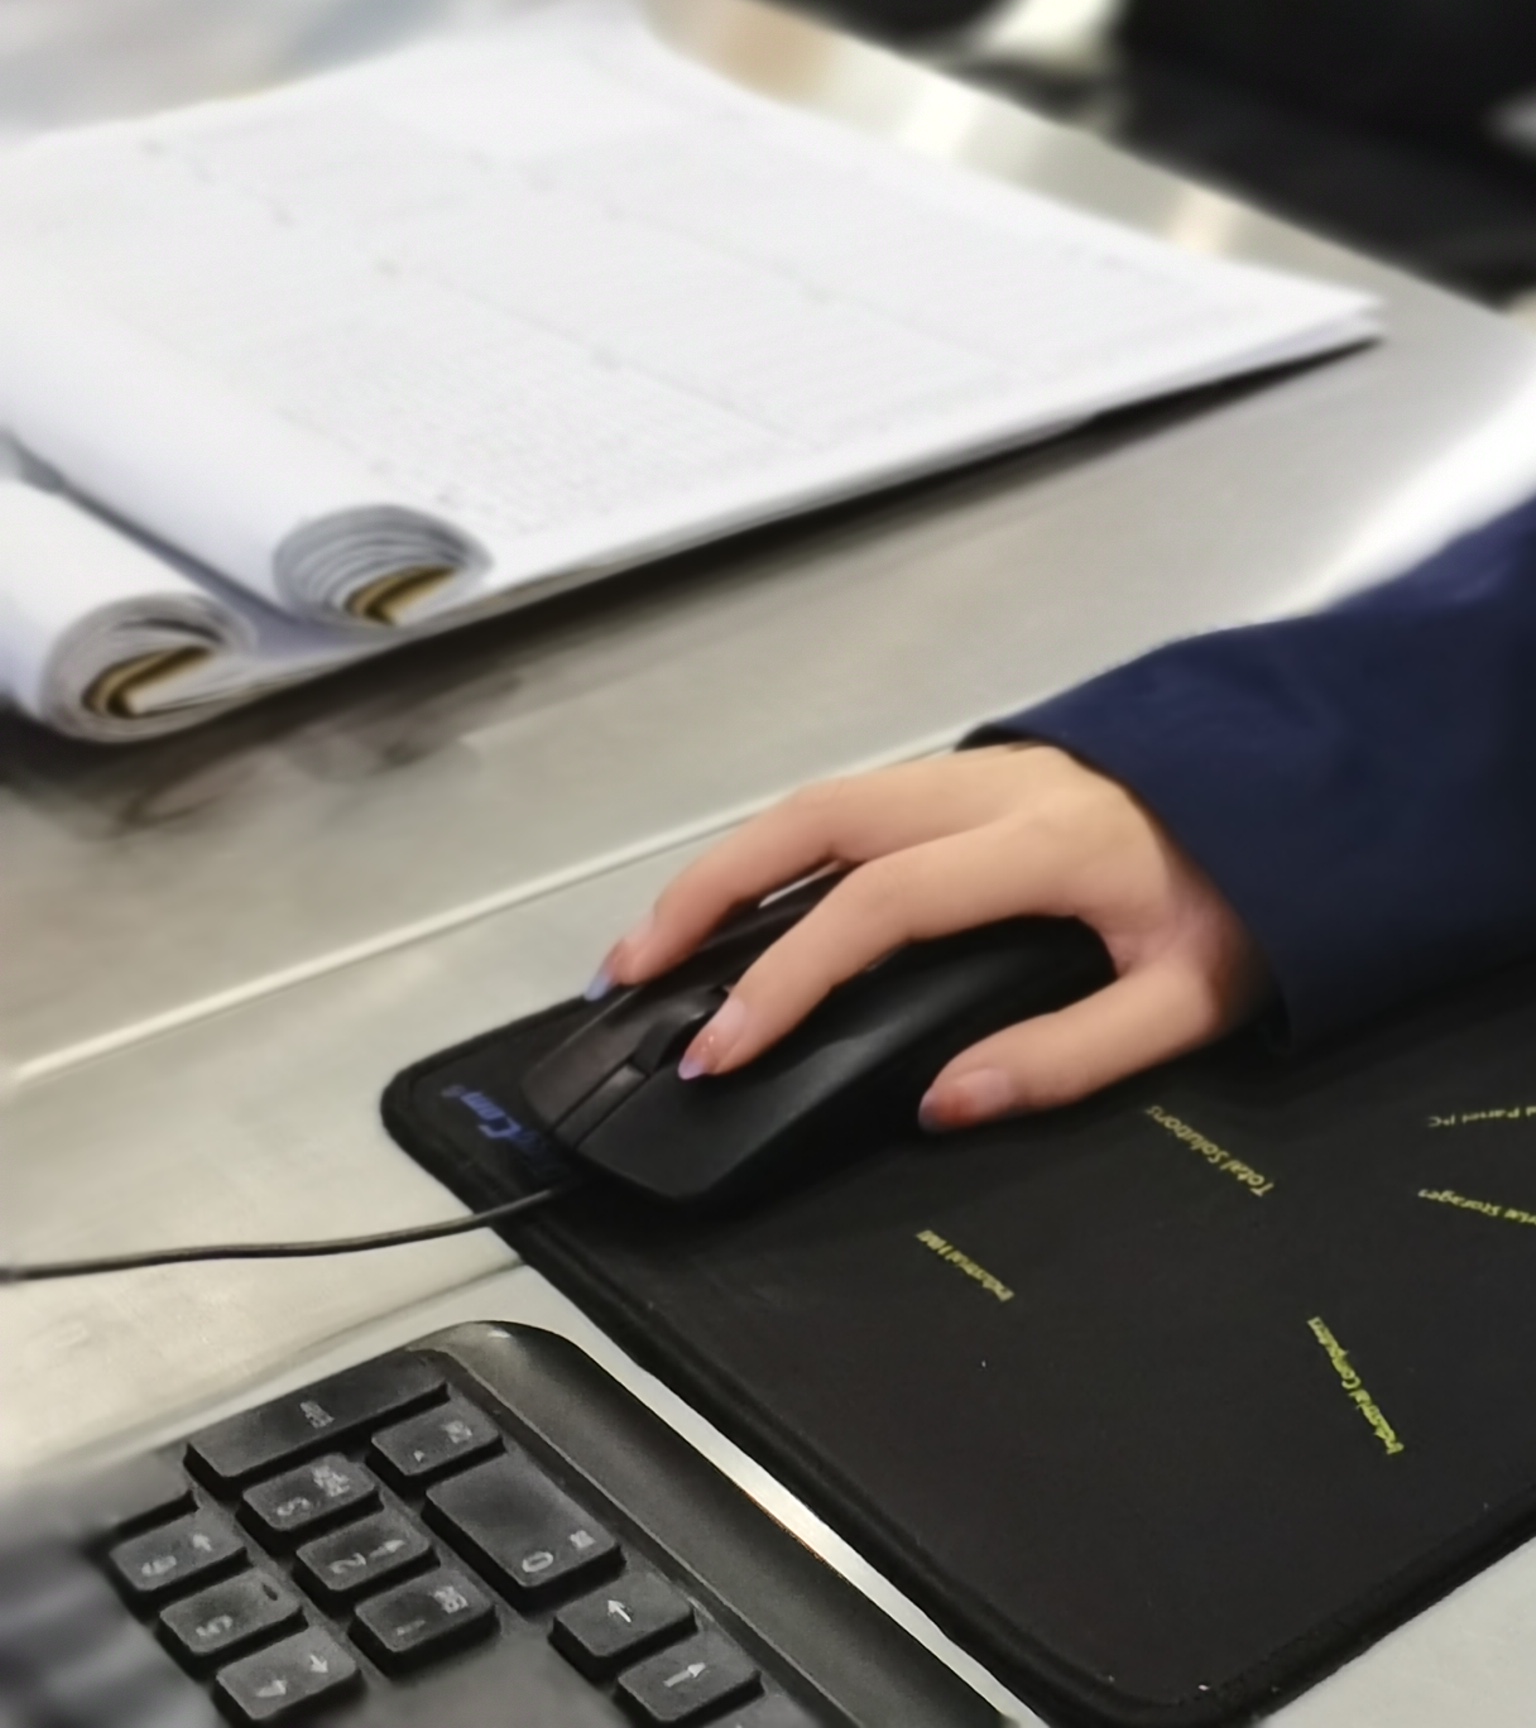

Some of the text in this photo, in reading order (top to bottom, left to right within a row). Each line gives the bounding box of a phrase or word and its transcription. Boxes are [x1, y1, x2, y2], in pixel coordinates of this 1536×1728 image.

[1462, 1106, 1520, 1125] Panel
[1144, 1104, 1275, 1198] Total Solutions
[1349, 1386, 1404, 1455] Industrial
[328, 1552, 367, 1574] 2
